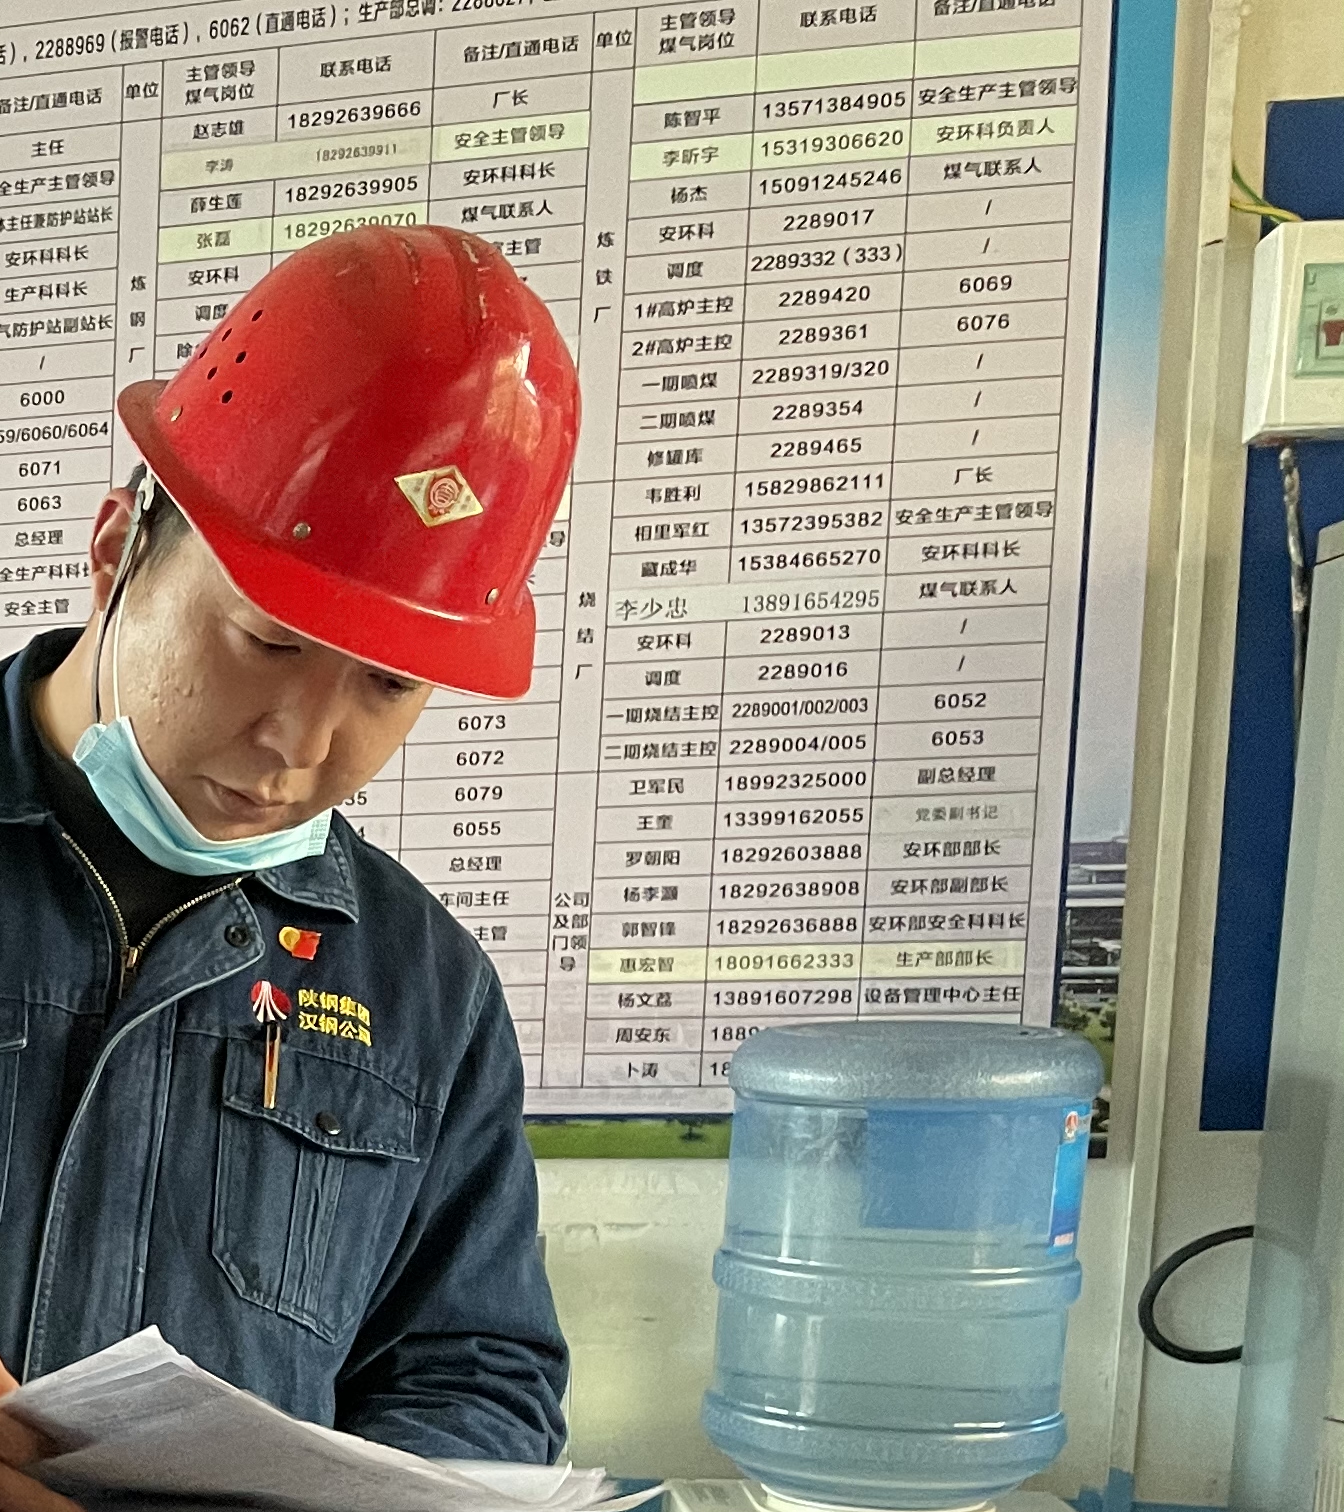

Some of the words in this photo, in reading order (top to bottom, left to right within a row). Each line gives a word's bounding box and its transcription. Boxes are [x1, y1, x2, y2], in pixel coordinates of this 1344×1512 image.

[660, 8, 735, 31] 主管领导
[800, 5, 877, 27] 联系电话
[596, 29, 632, 48] 单位
[658, 32, 734, 55] 煤气岗位
[464, 35, 579, 63] 备注/直通电话
[186, 60, 255, 83] 主管领导
[320, 55, 391, 78] 联系电话
[126, 82, 158, 99] 单位
[185, 83, 254, 105] 煤气岗位
[493, 90, 528, 109] 厂长
[918, 78, 1078, 106] 安全生产主管领导
[288, 101, 420, 128] 18292639666
[764, 92, 905, 118] 13571384905
[455, 123, 564, 149] 安全主管领导
[937, 117, 1055, 143] 安环科负责人
[31, 139, 64, 157] 主任
[762, 130, 903, 157] 15319306620
[464, 162, 555, 186] 安环科科长
[944, 157, 1041, 180] 煤气联系人
[286, 176, 417, 202] 18292639905
[760, 169, 901, 195] 15091245246
[671, 186, 707, 204] 杨杰
[461, 199, 553, 223] 煤气联系人
[783, 209, 874, 231] 2289017
[659, 222, 714, 243] 安环科
[5, 245, 88, 268] 安环科科长
[188, 266, 239, 286] 安环科
[667, 261, 703, 279] 调度
[4, 281, 87, 303] 生产科科长
[960, 275, 1012, 293] 6069
[779, 286, 870, 307] 2289420
[957, 314, 1009, 331] 6076
[779, 324, 867, 345] 2289361
[752, 360, 889, 384] 2289319/320
[20, 390, 64, 407] 6000
[772, 400, 862, 420] 2289354
[771, 437, 861, 458] 2289465
[19, 461, 59, 477] 6071
[954, 466, 992, 484] 厂长
[746, 473, 883, 497] 15829862111
[18, 496, 61, 511] 6063
[896, 502, 1053, 525] 安全生产主管领导
[741, 512, 882, 534] 13572395382
[15, 530, 63, 547] 总经理
[739, 549, 880, 571] 15384665270
[922, 540, 1020, 562] 安环科科长
[919, 578, 1017, 599] 煤气联系人
[5, 599, 69, 617] 安全主管
[744, 590, 879, 613] 13891654295
[638, 632, 691, 651] 安环科
[760, 625, 849, 643] 2289013
[645, 670, 681, 686] 调度
[758, 662, 847, 680] 2289016
[732, 698, 868, 718] 2289001/002/003
[935, 693, 986, 709] 6052
[459, 715, 505, 731] 6073
[729, 735, 866, 754] 2289004/005
[932, 730, 983, 746] 6053
[457, 750, 503, 766] 6072
[725, 772, 866, 791] 18992325000
[918, 766, 995, 784] 副总经理
[455, 786, 502, 801] 6079
[724, 808, 863, 827] 13399162055
[453, 821, 500, 836] 6055
[722, 844, 861, 863] 18292603888
[903, 839, 1000, 858] 安环部部长
[449, 856, 501, 872] 总经理
[720, 881, 859, 899] 18292638908
[891, 875, 1008, 895] 安环部副部长
[554, 891, 590, 908] 公司
[717, 917, 857, 934] 18292636888
[869, 912, 1025, 932] 安环部安全科科长
[716, 953, 853, 970] 18091662333
[896, 949, 993, 967] 生产部部长
[714, 982, 852, 1005] 13891607298
[298, 988, 371, 1027] 陕钢集团
[298, 1011, 372, 1048] 汉钢公司
[616, 1027, 670, 1043] 周安东
